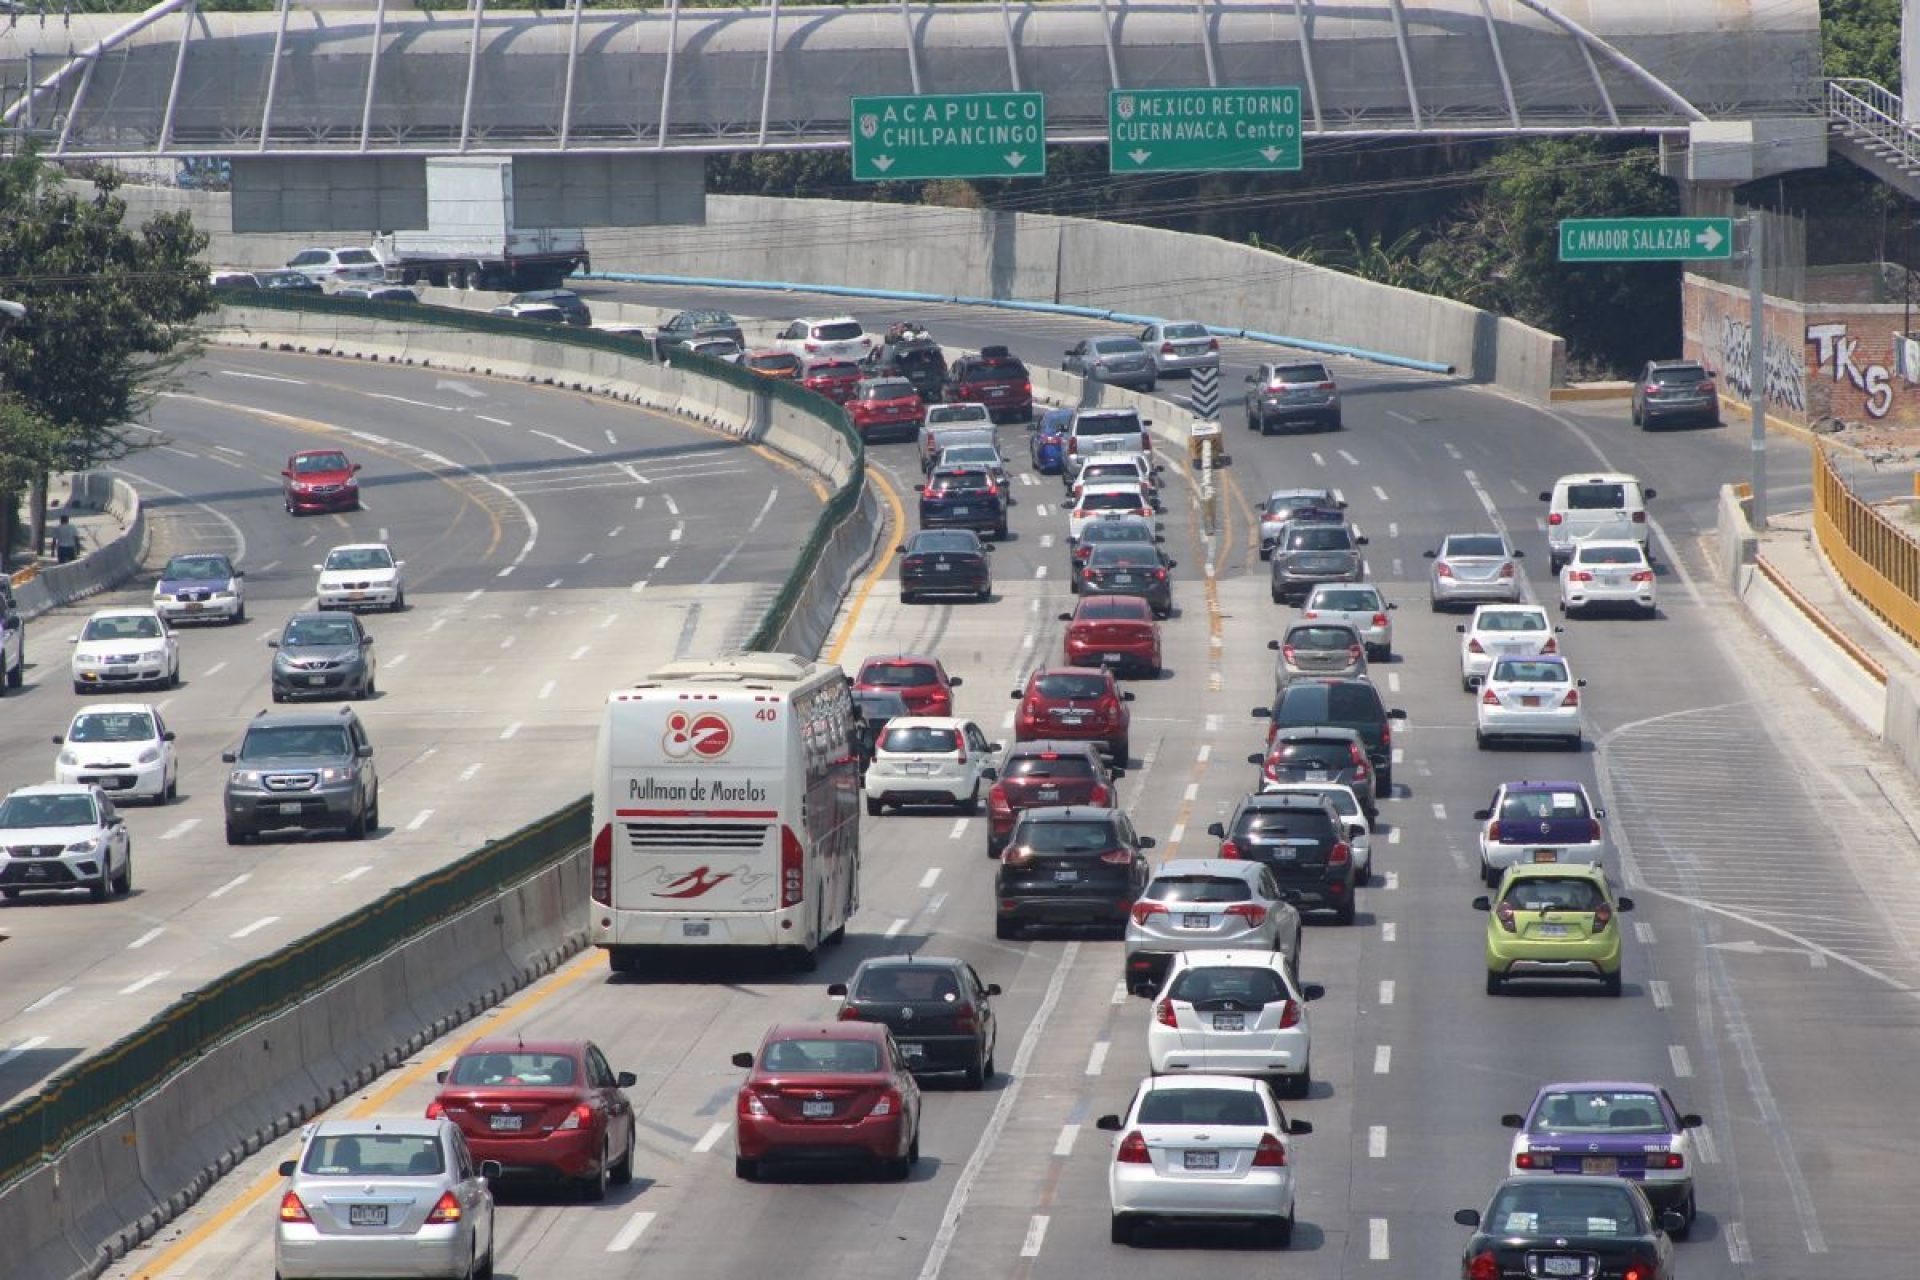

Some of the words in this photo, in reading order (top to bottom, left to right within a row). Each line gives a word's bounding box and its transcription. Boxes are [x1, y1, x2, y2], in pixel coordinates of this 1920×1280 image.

[884, 102, 1037, 122] ACAPULCO
[1140, 98, 1206, 116] MEXICO
[1212, 96, 1294, 115] RETORNO
[884, 125, 1038, 147] CHILPANCINGO
[1116, 121, 1228, 141] CUERNAVACA
[1236, 120, 1295, 138] Centro
[1567, 230, 1575, 250] C
[1579, 230, 1628, 250] AMADOR
[1633, 229, 1691, 249] SALAZAR
[1806, 322, 1893, 418] TKS
[755, 708, 776, 721] 40
[630, 778, 686, 800] Pullman
[690, 777, 706, 800] de
[711, 779, 766, 800] Morelos
